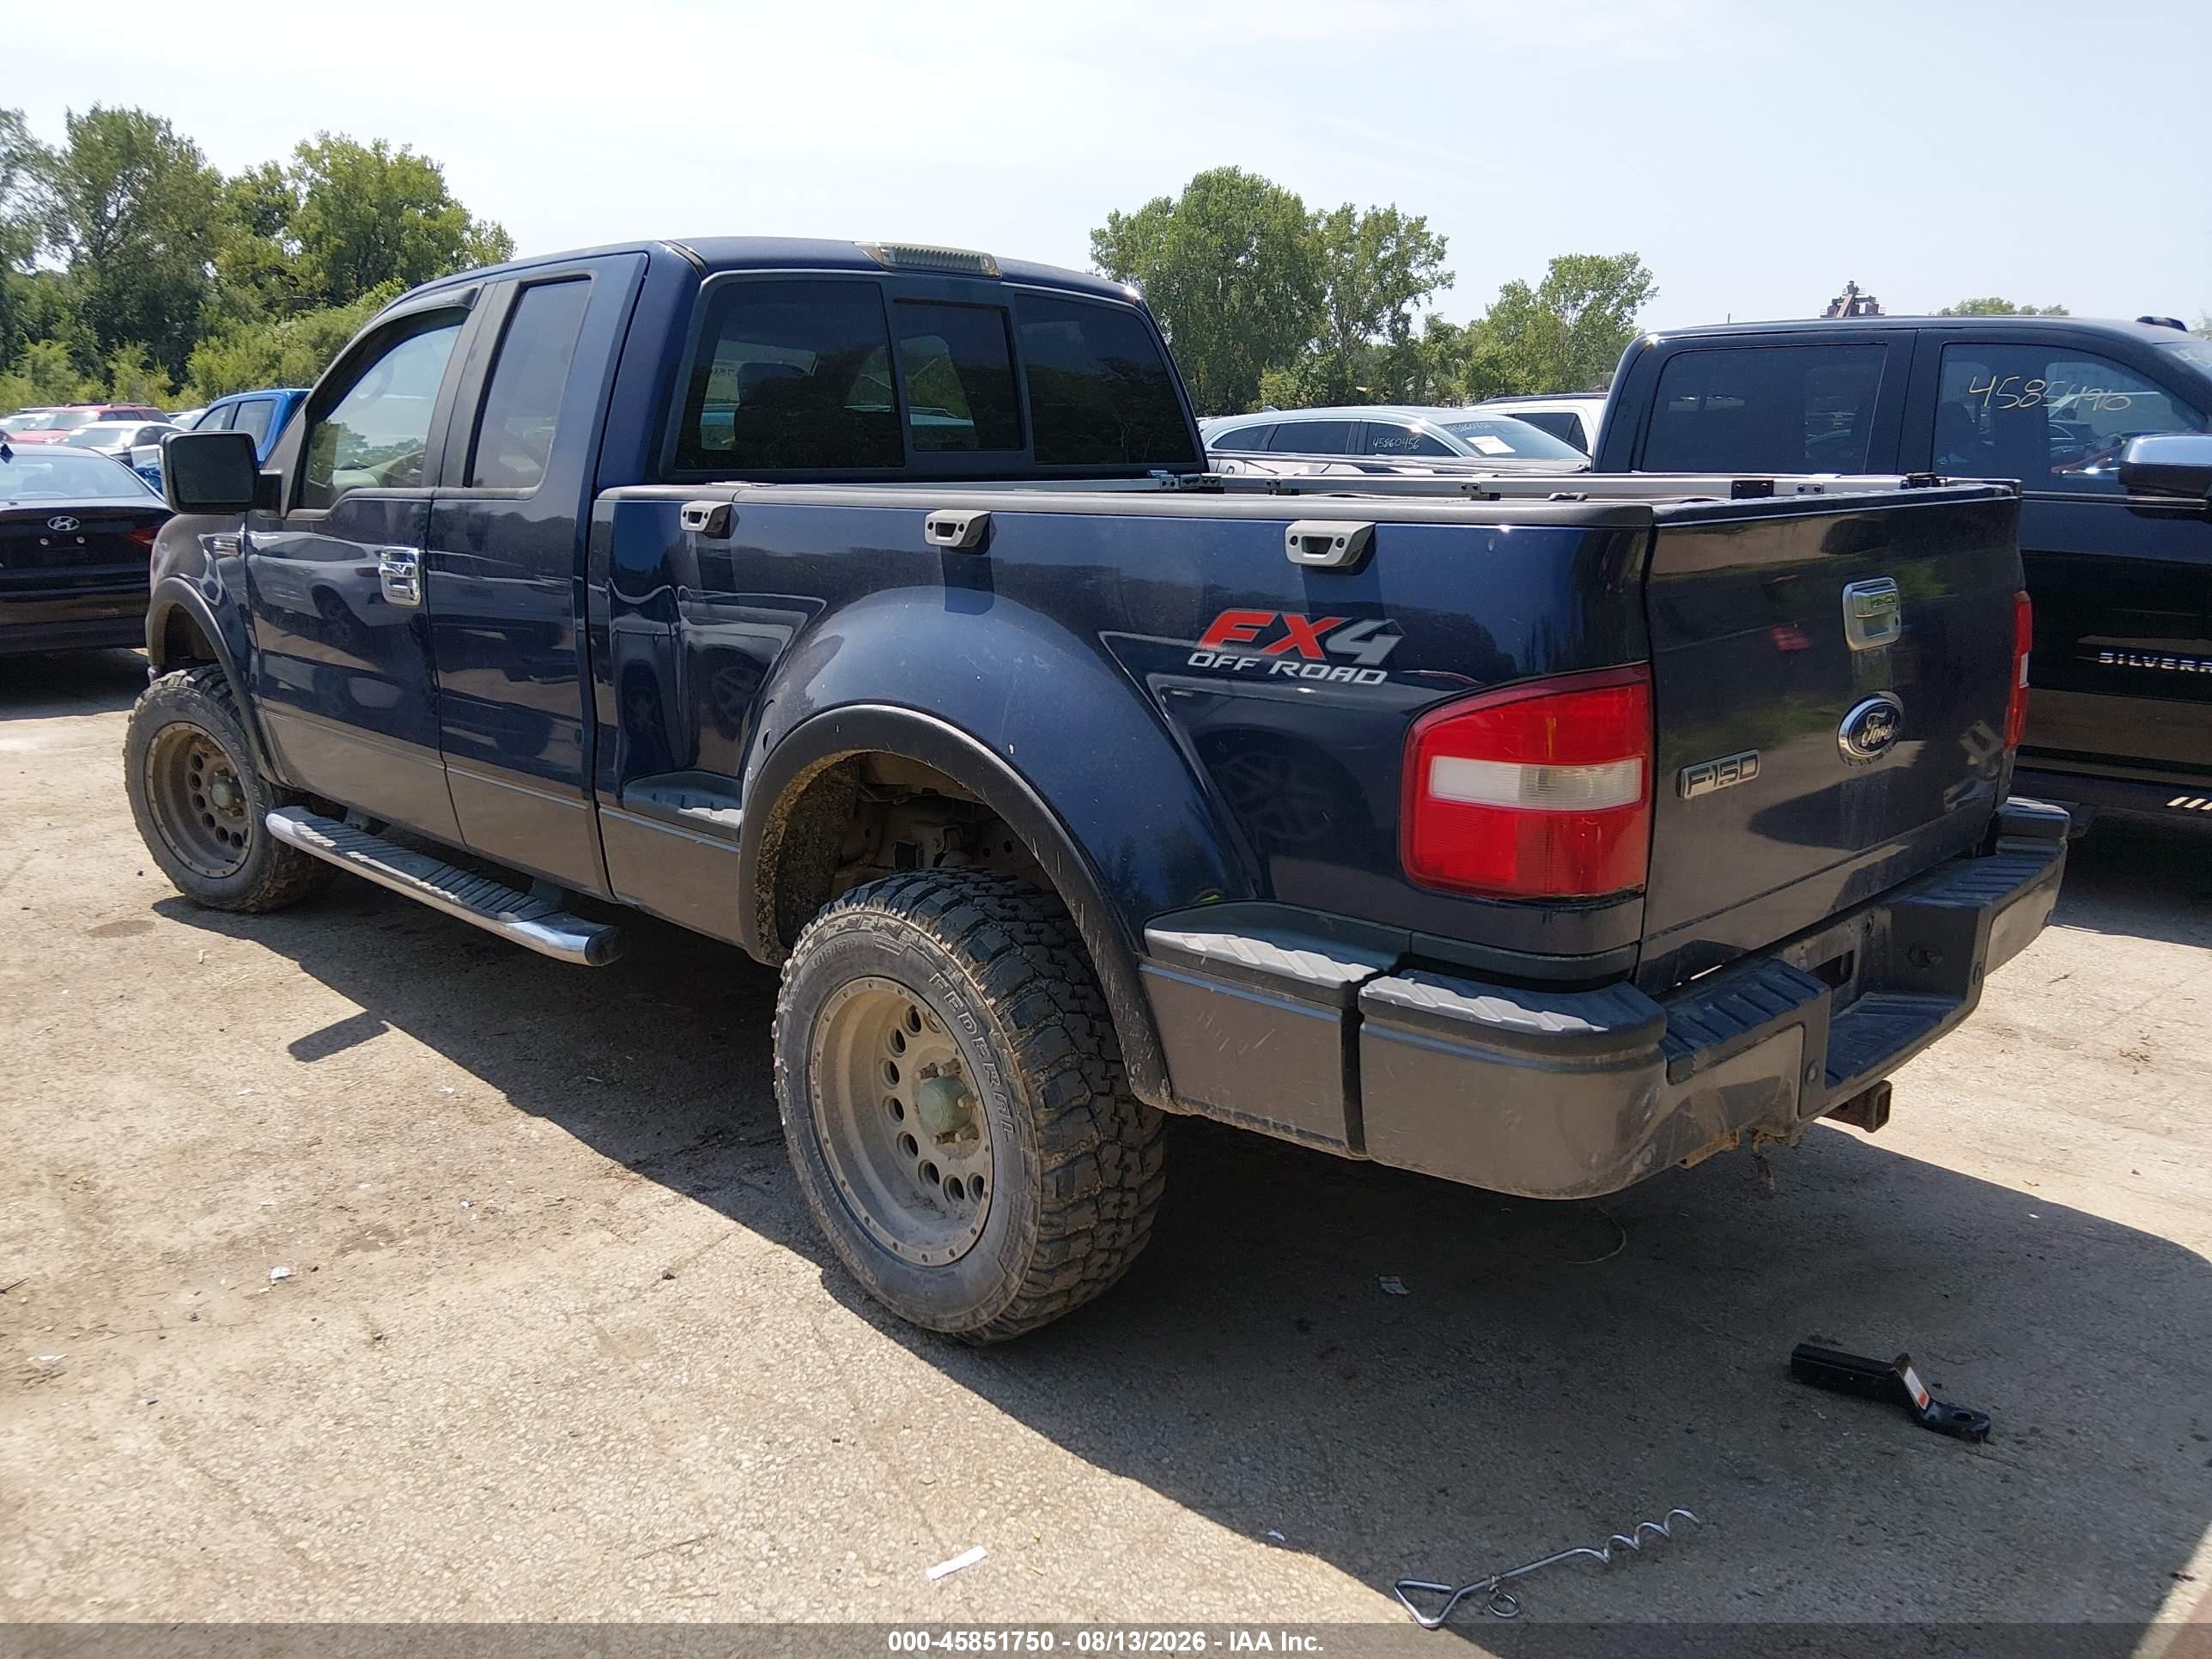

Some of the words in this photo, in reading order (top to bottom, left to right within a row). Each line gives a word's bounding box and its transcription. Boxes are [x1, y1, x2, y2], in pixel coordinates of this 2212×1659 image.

[1372, 435, 1421, 450] 45860456
[1197, 608, 1407, 665] FX4
[1187, 652, 1261, 672] OFF
[1267, 659, 1389, 685] ROAD
[1861, 709, 1897, 747] Ford
[928, 972, 1016, 1143] FEDERAL
